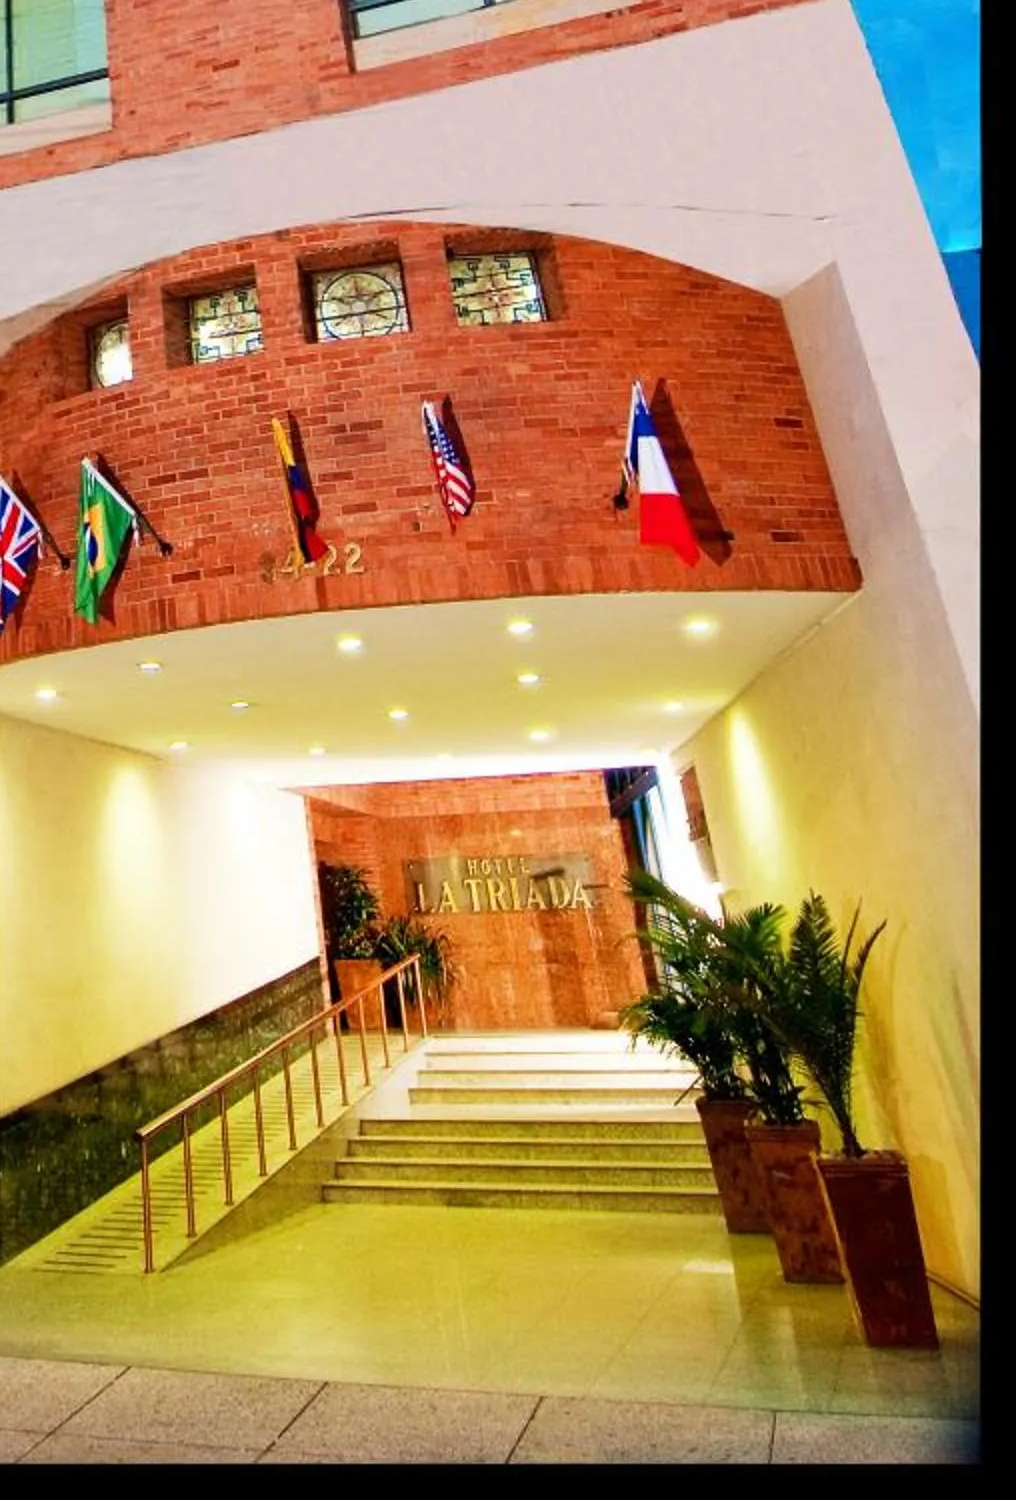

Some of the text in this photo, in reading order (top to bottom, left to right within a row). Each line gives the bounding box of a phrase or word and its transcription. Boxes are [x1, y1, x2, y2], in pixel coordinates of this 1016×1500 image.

[467, 857, 530, 875] HOTEL
[414, 875, 594, 913] LA TRIADA
